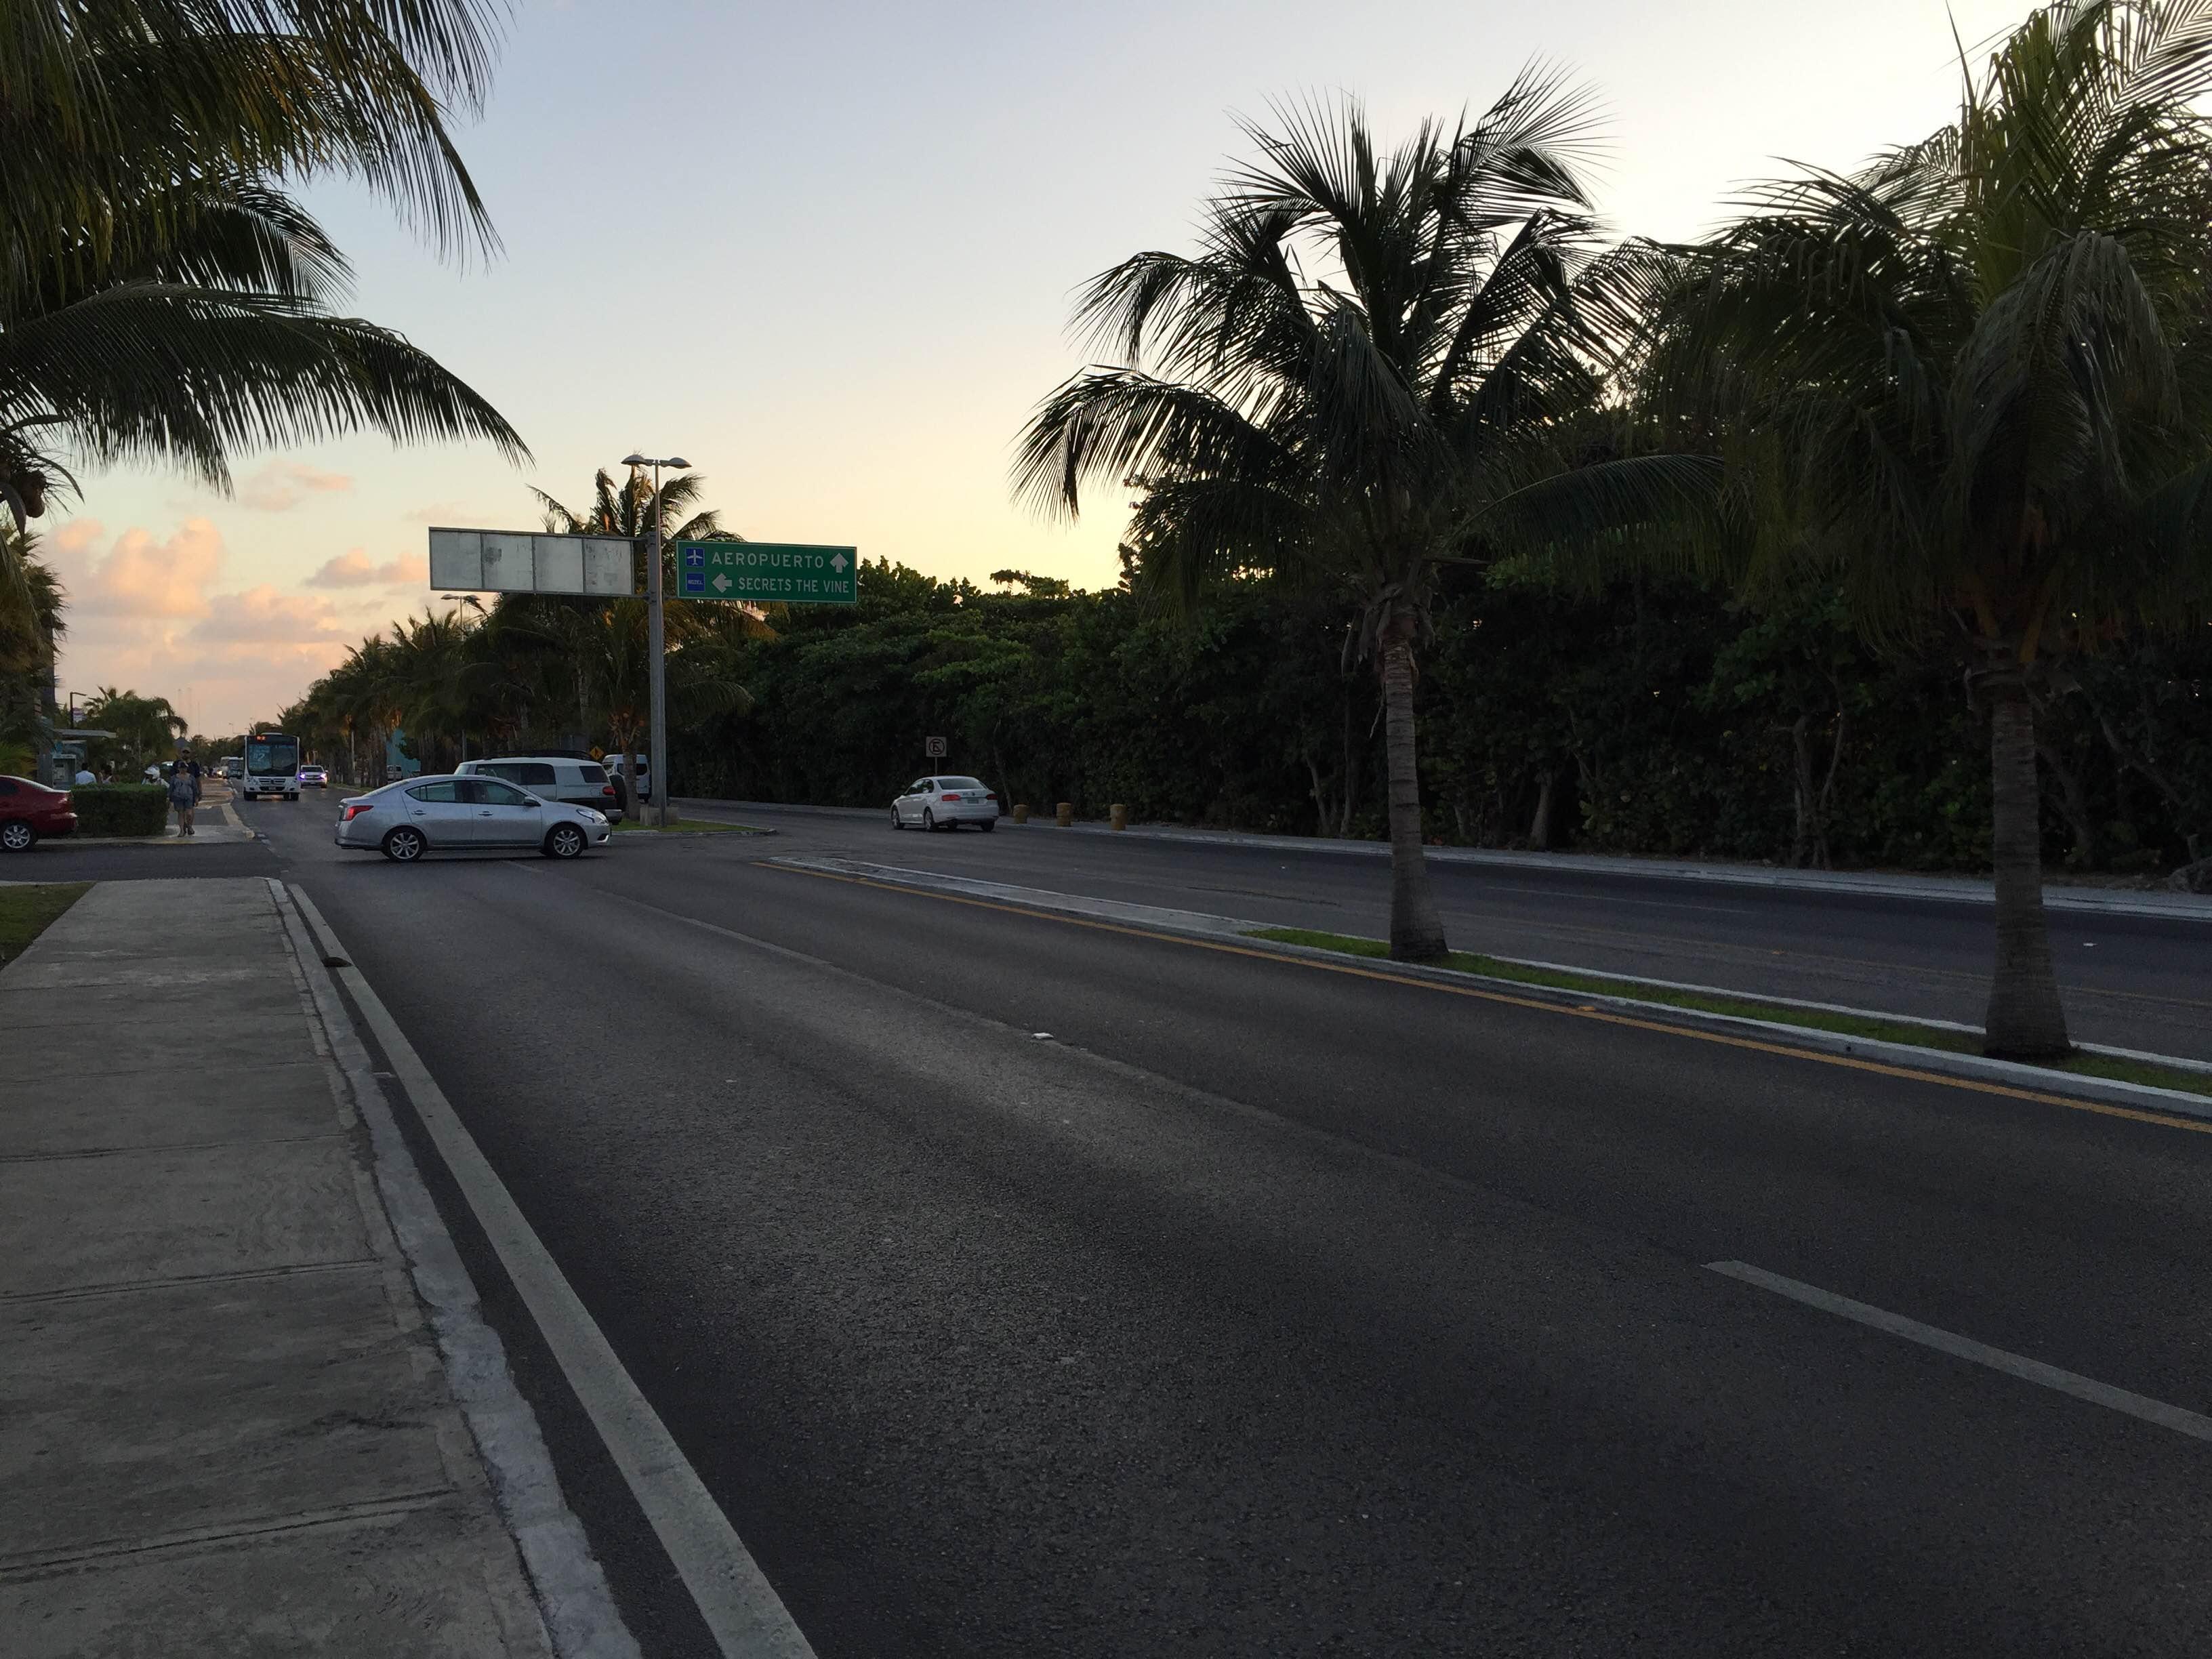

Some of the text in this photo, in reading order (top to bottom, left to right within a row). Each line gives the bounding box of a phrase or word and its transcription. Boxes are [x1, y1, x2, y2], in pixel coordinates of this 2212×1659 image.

[712, 552, 823, 568] AEROPUERTO
[738, 577, 849, 593] SECRETS THE VINE
